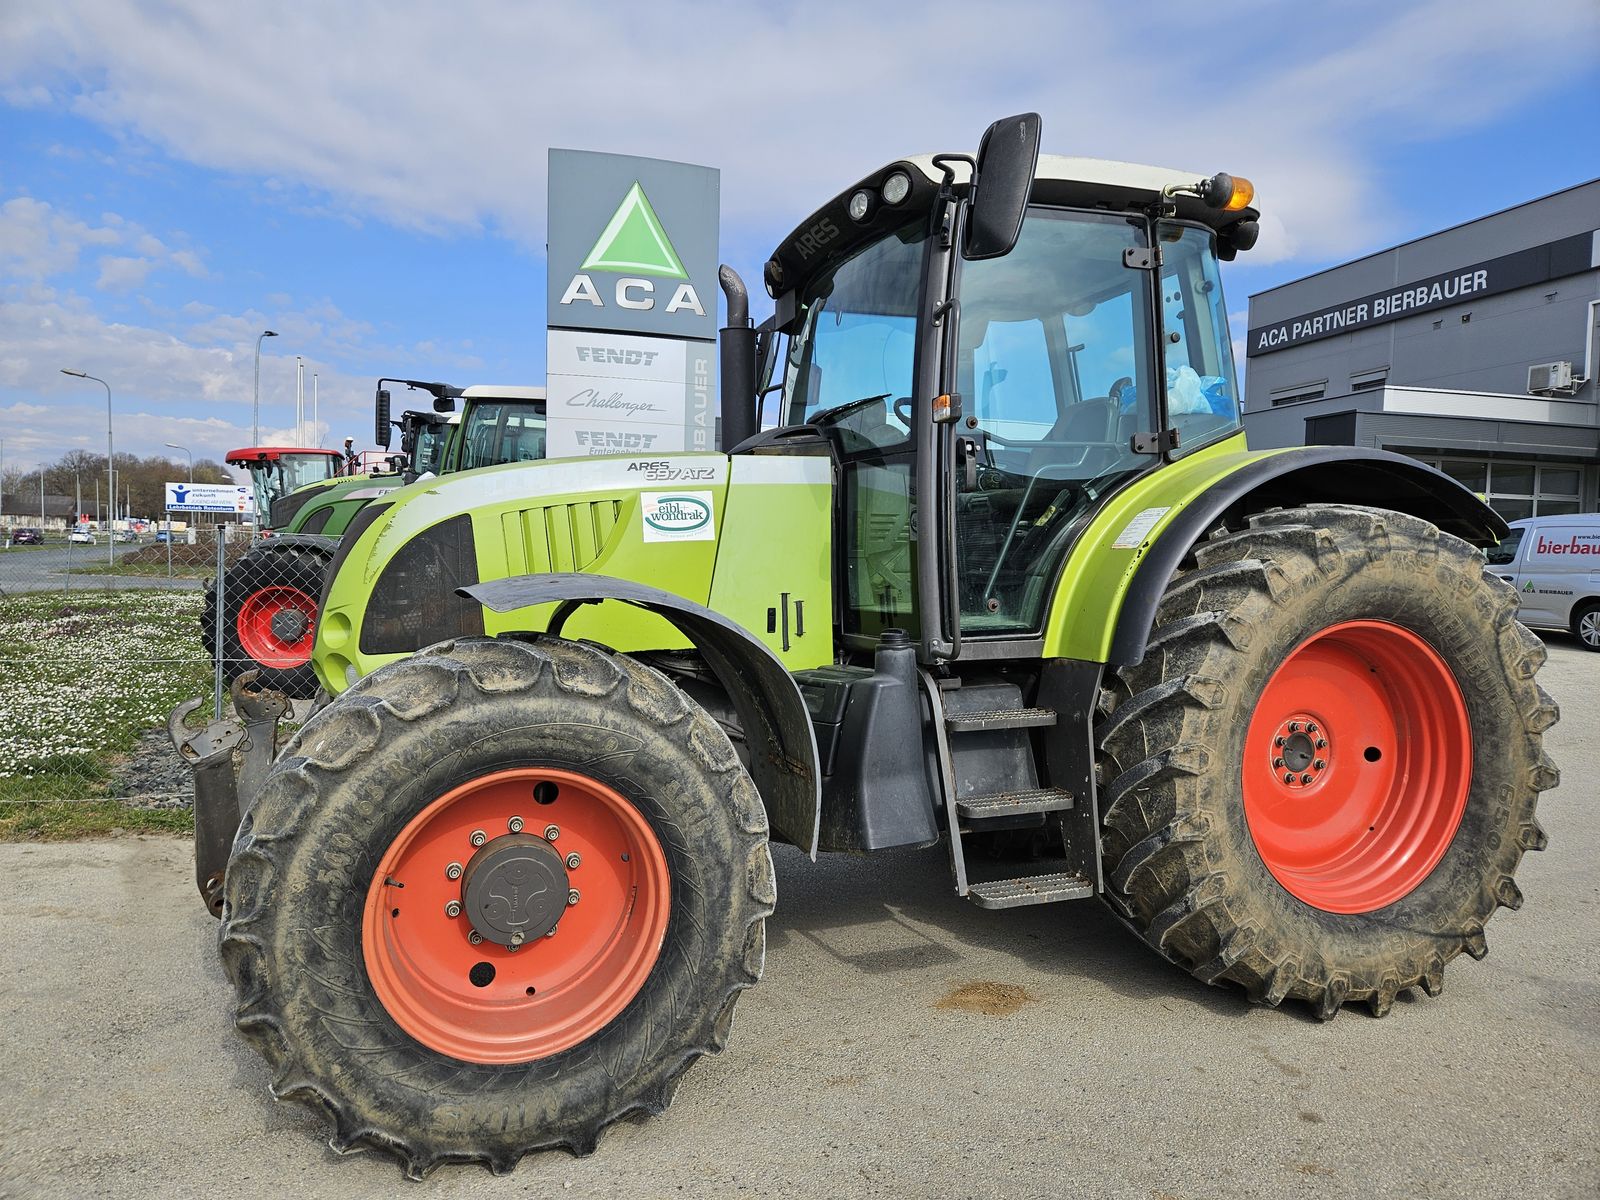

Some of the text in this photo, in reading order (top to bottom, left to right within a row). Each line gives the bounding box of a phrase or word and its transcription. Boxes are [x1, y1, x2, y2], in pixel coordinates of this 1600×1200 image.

[794, 217, 840, 260] ARES
[559, 273, 707, 317] ACA
[1258, 269, 1488, 350] ACA PARTNER BIERBAUER
[575, 346, 659, 367] FENDT
[565, 387, 668, 417] Challenger
[575, 430, 658, 448] FENDT
[627, 461, 670, 472] ARES
[650, 510, 704, 521] wondrak
[658, 503, 680, 513] eibl
